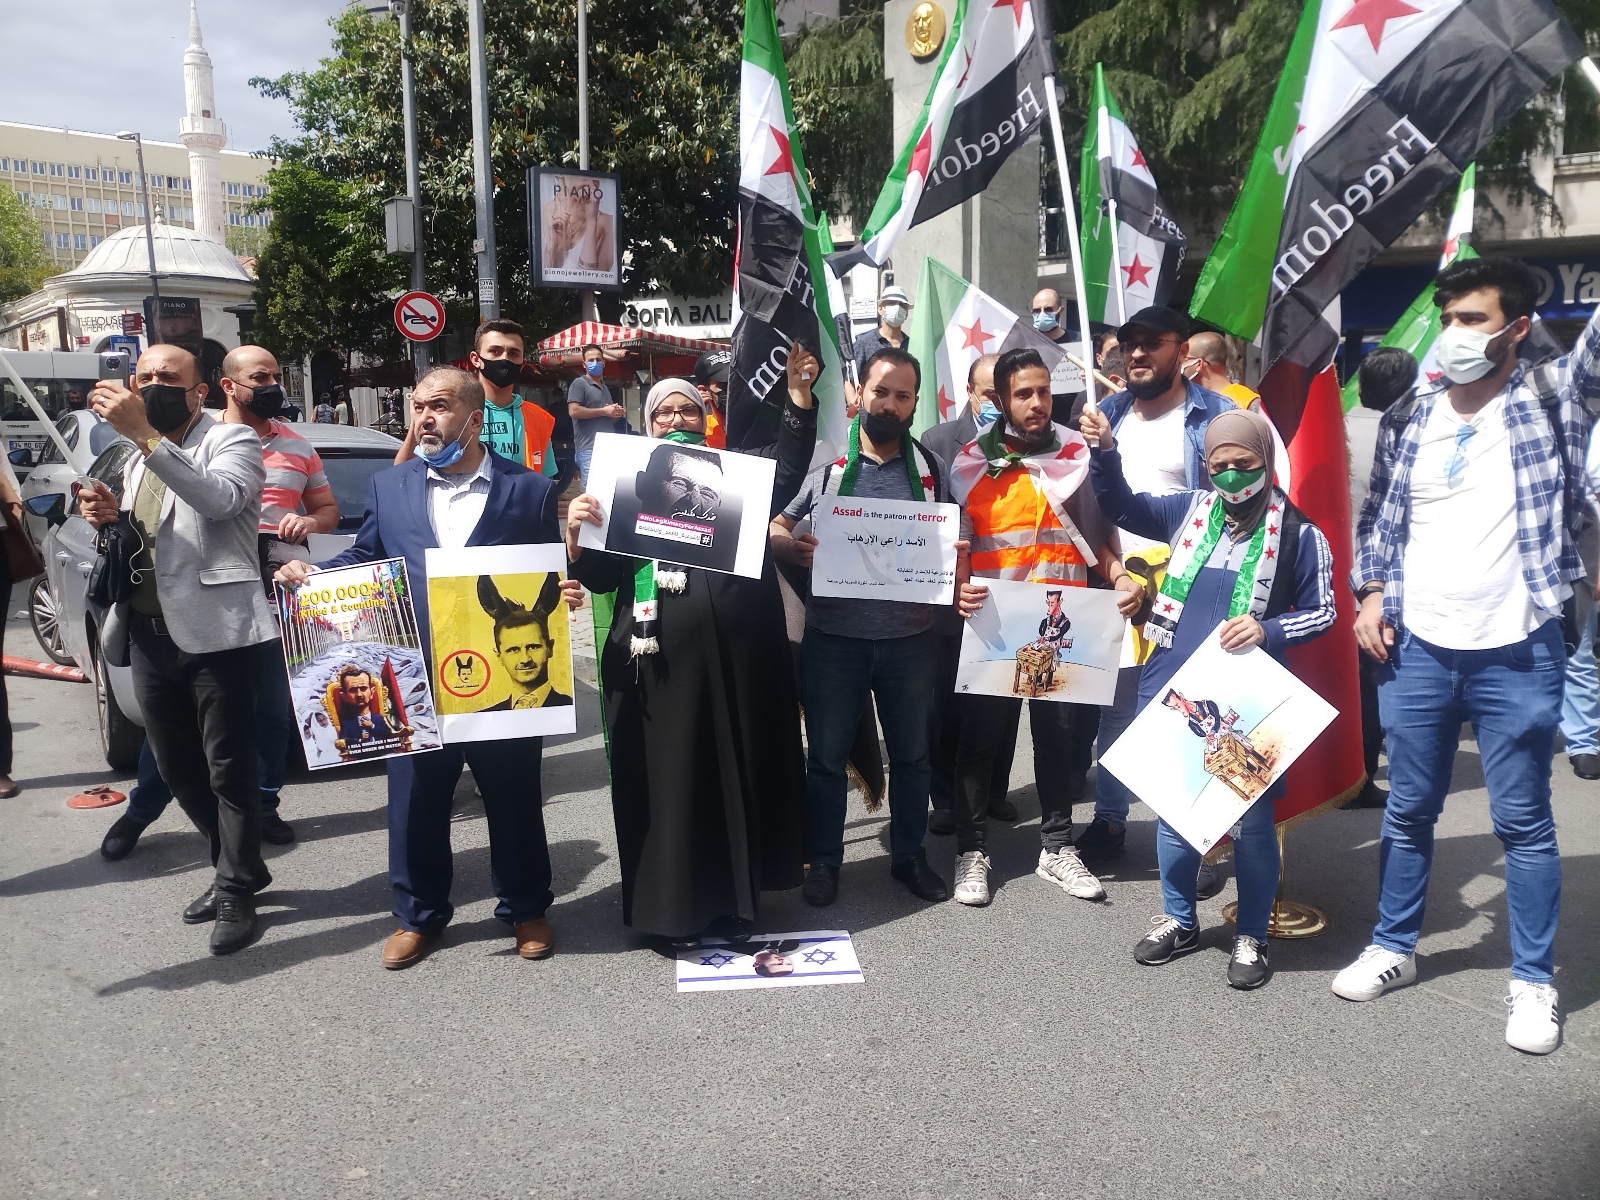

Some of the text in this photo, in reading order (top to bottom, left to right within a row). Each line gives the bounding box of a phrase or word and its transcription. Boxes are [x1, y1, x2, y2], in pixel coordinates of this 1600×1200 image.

[553, 184, 604, 200] PIANO
[544, 268, 615, 279] pianojewellery.com
[627, 303, 684, 328] SOFIA
[500, 442, 520, 455] AND
[832, 506, 863, 517] Assad
[871, 511, 883, 519] the
[884, 513, 907, 521] patron
[918, 512, 948, 523] terror
[880, 536, 903, 548] راعي
[906, 535, 926, 547] الأسد
[299, 581, 381, 608] 200,000+
[299, 598, 387, 619] Killed & Counting
